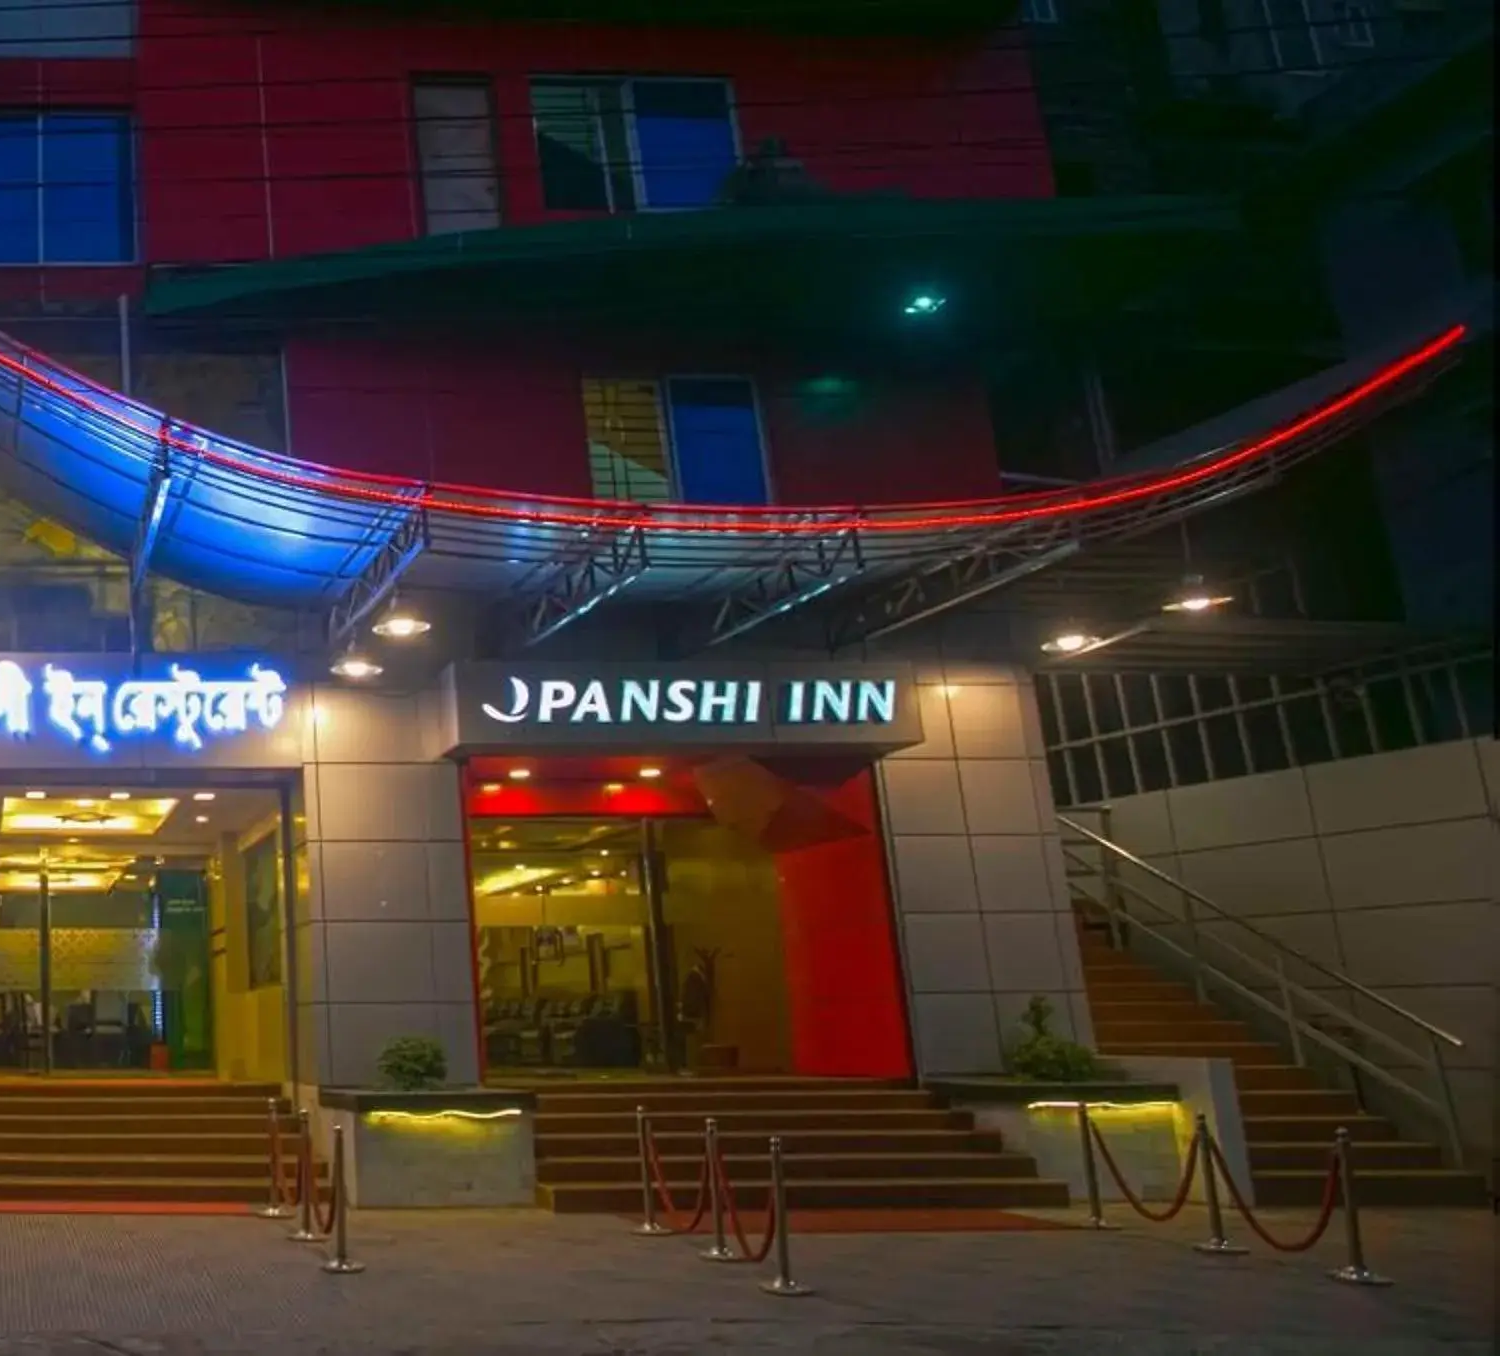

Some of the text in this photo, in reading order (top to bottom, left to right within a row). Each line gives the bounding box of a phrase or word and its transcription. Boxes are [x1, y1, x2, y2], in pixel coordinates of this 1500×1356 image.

[113, 662, 287, 749] রেস্টুরেন্ট
[537, 679, 896, 723] PANSHI INN
